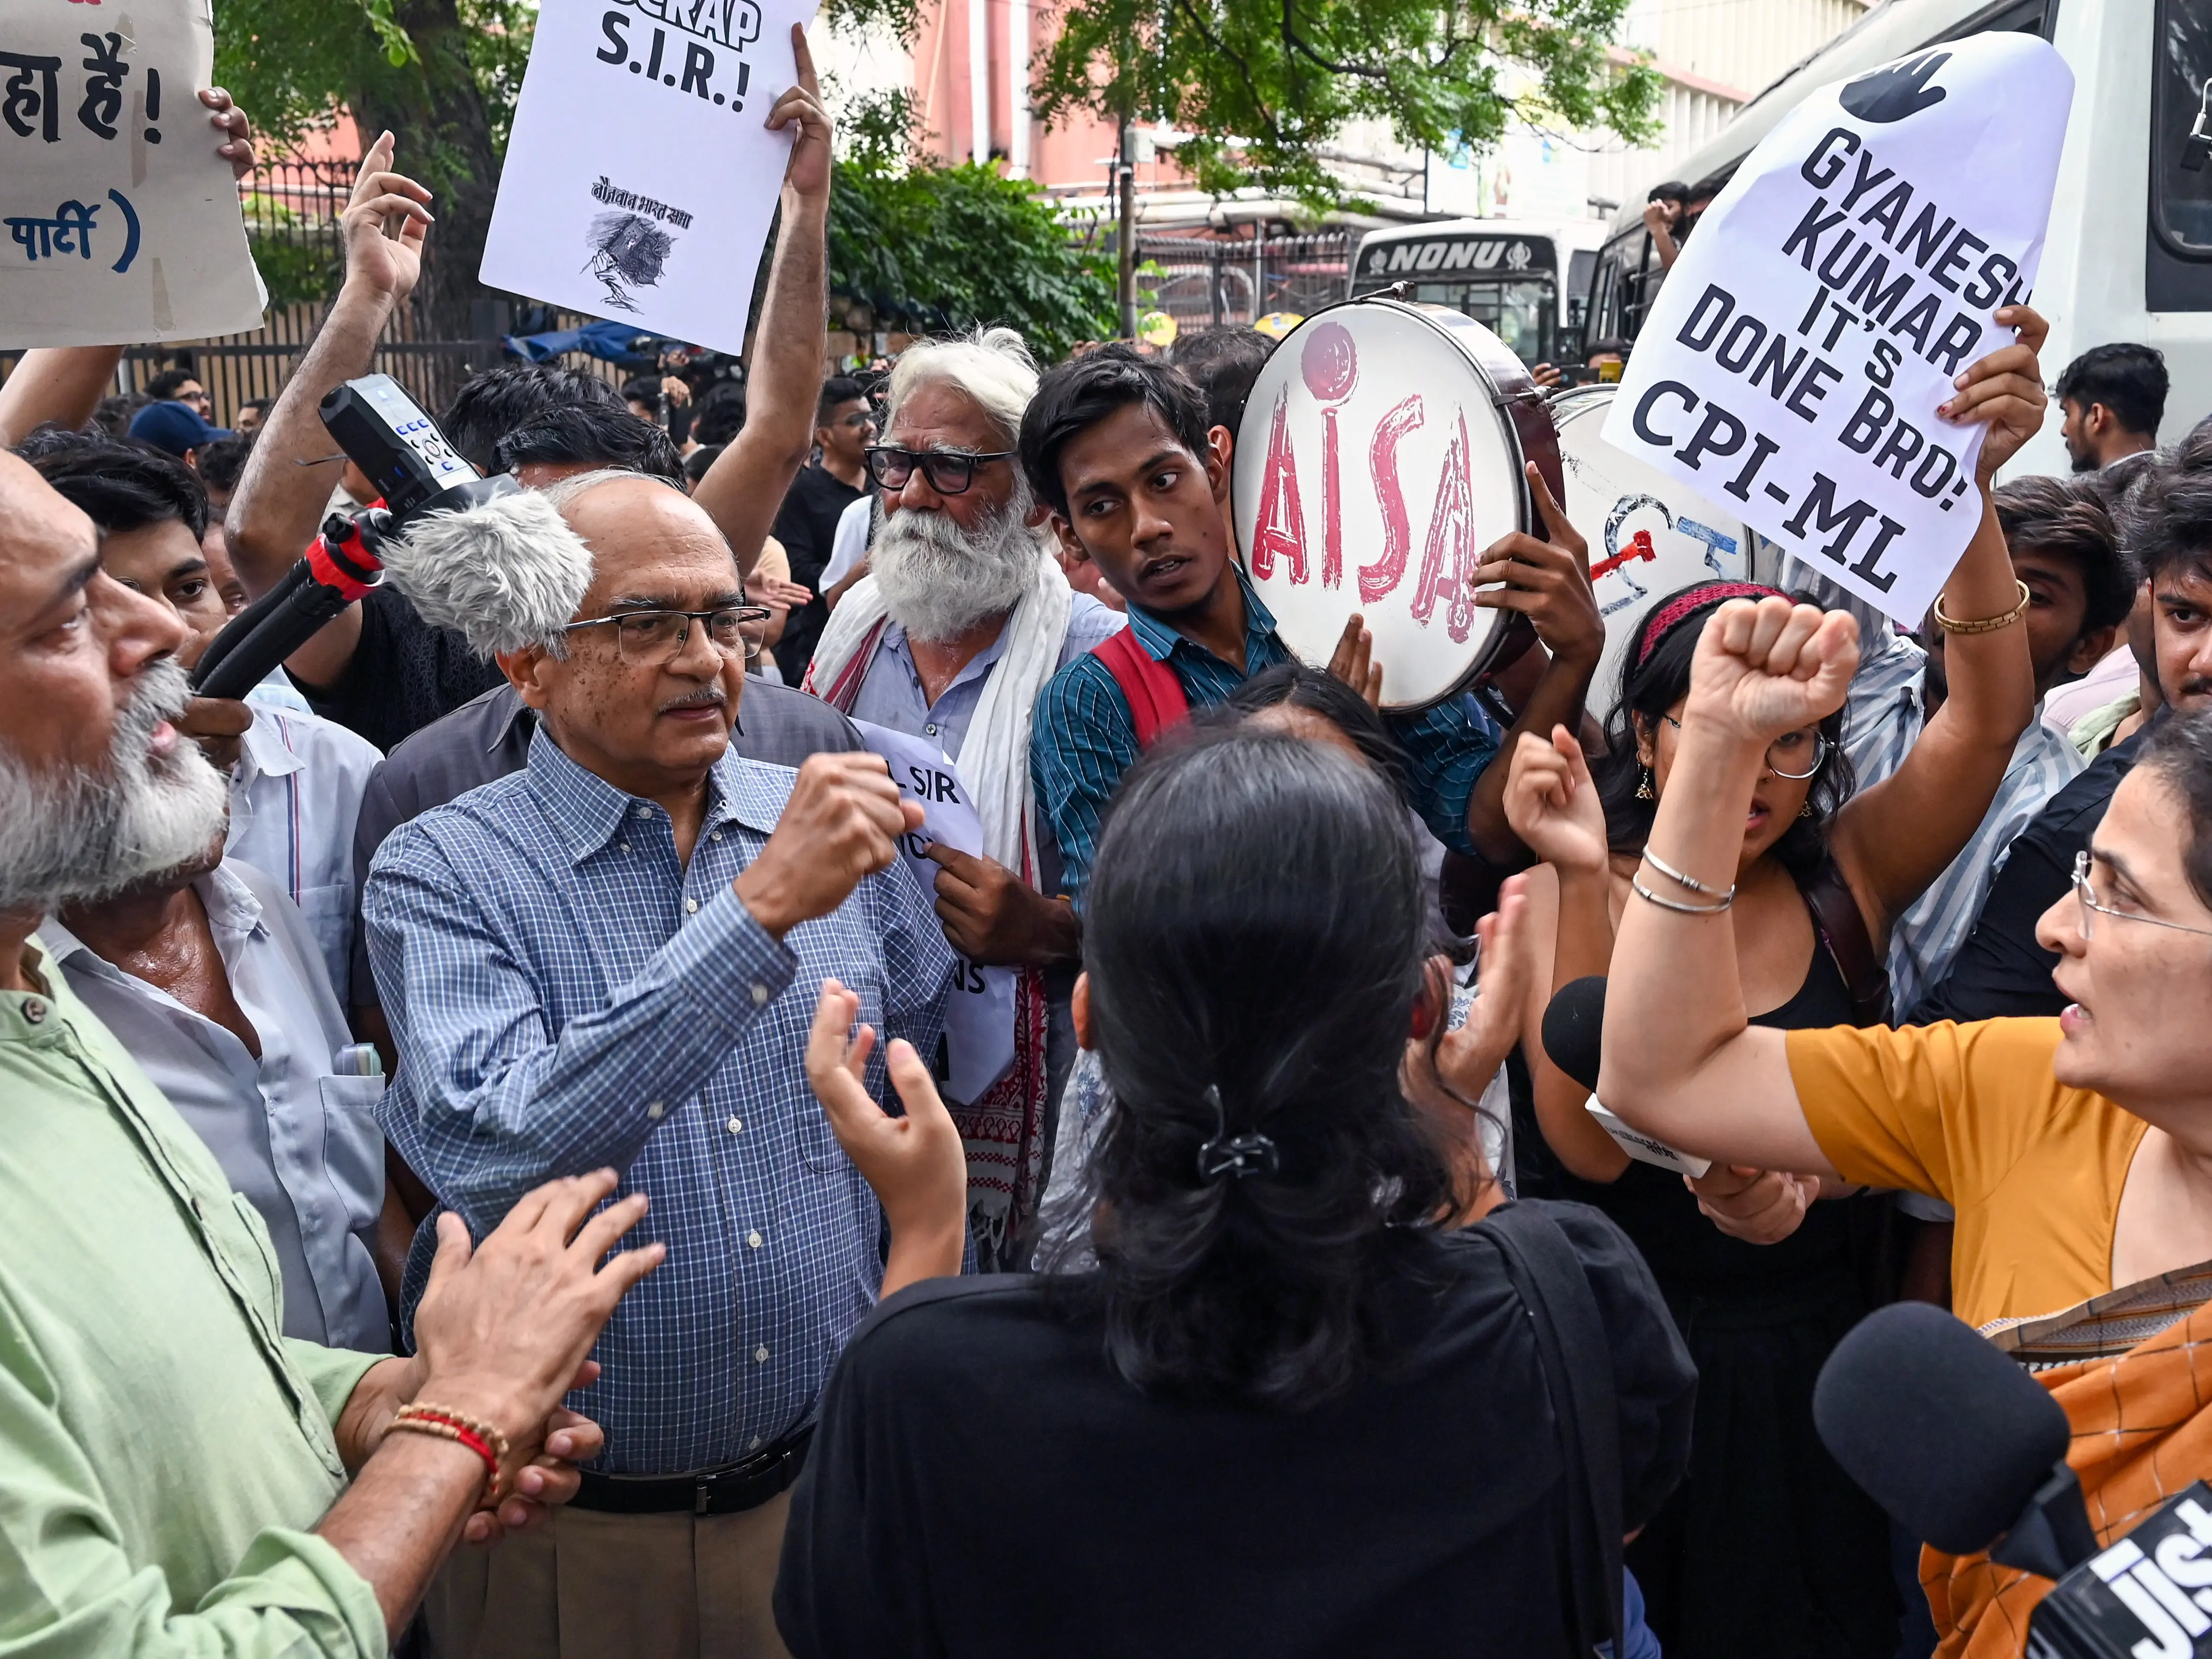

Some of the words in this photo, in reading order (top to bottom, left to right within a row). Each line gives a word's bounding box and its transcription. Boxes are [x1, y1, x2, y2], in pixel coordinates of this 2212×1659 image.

[610, 0, 761, 53] RAP
[637, 196, 668, 220] भारत
[1387, 241, 1507, 271] NONU
[1782, 196, 1982, 376] KUMAR
[1676, 283, 1843, 423] DONE
[1838, 385, 1968, 511] BRO!
[1632, 380, 1906, 593] CPI-ML
[909, 766, 960, 804] SIR
